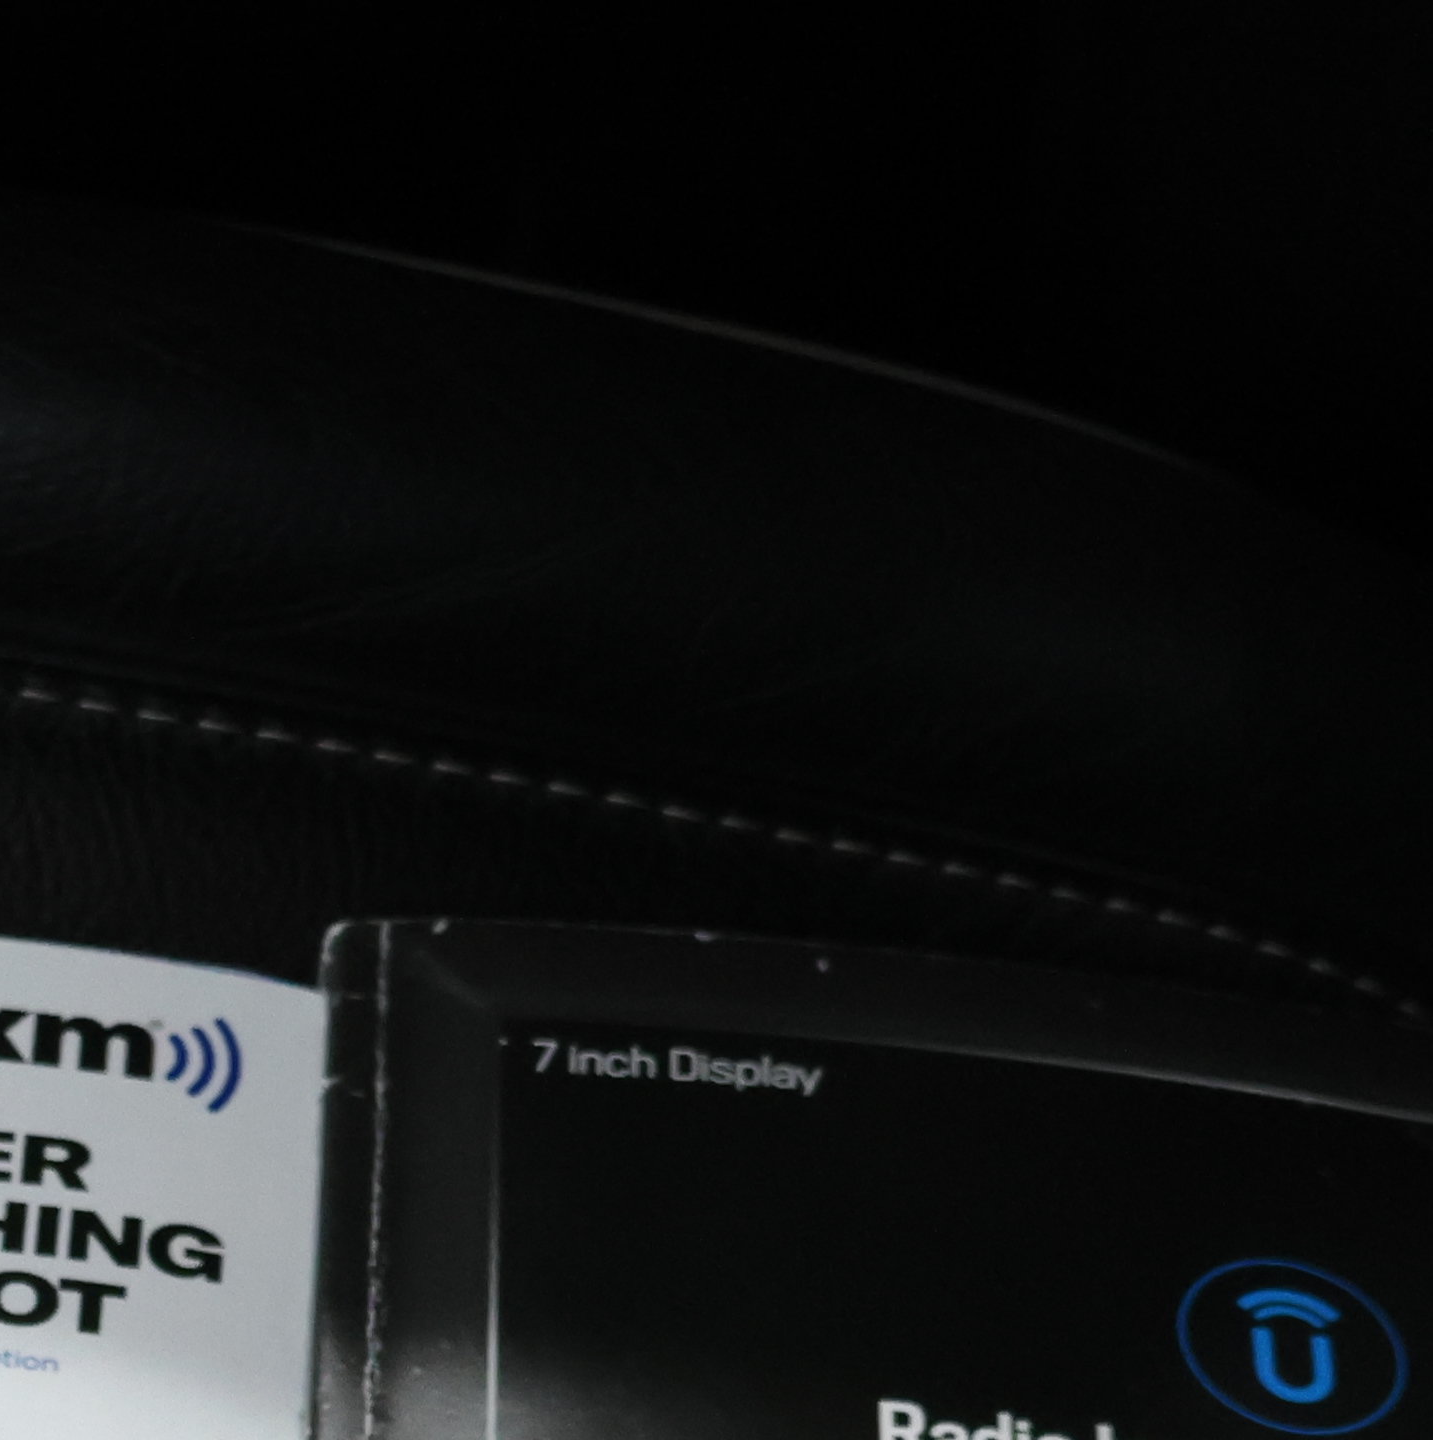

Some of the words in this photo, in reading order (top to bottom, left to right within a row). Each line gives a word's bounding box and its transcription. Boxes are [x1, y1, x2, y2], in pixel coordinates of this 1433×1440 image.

[532, 1040, 559, 1074] 7
[568, 1043, 656, 1081] inch
[670, 1048, 824, 1097] Display
